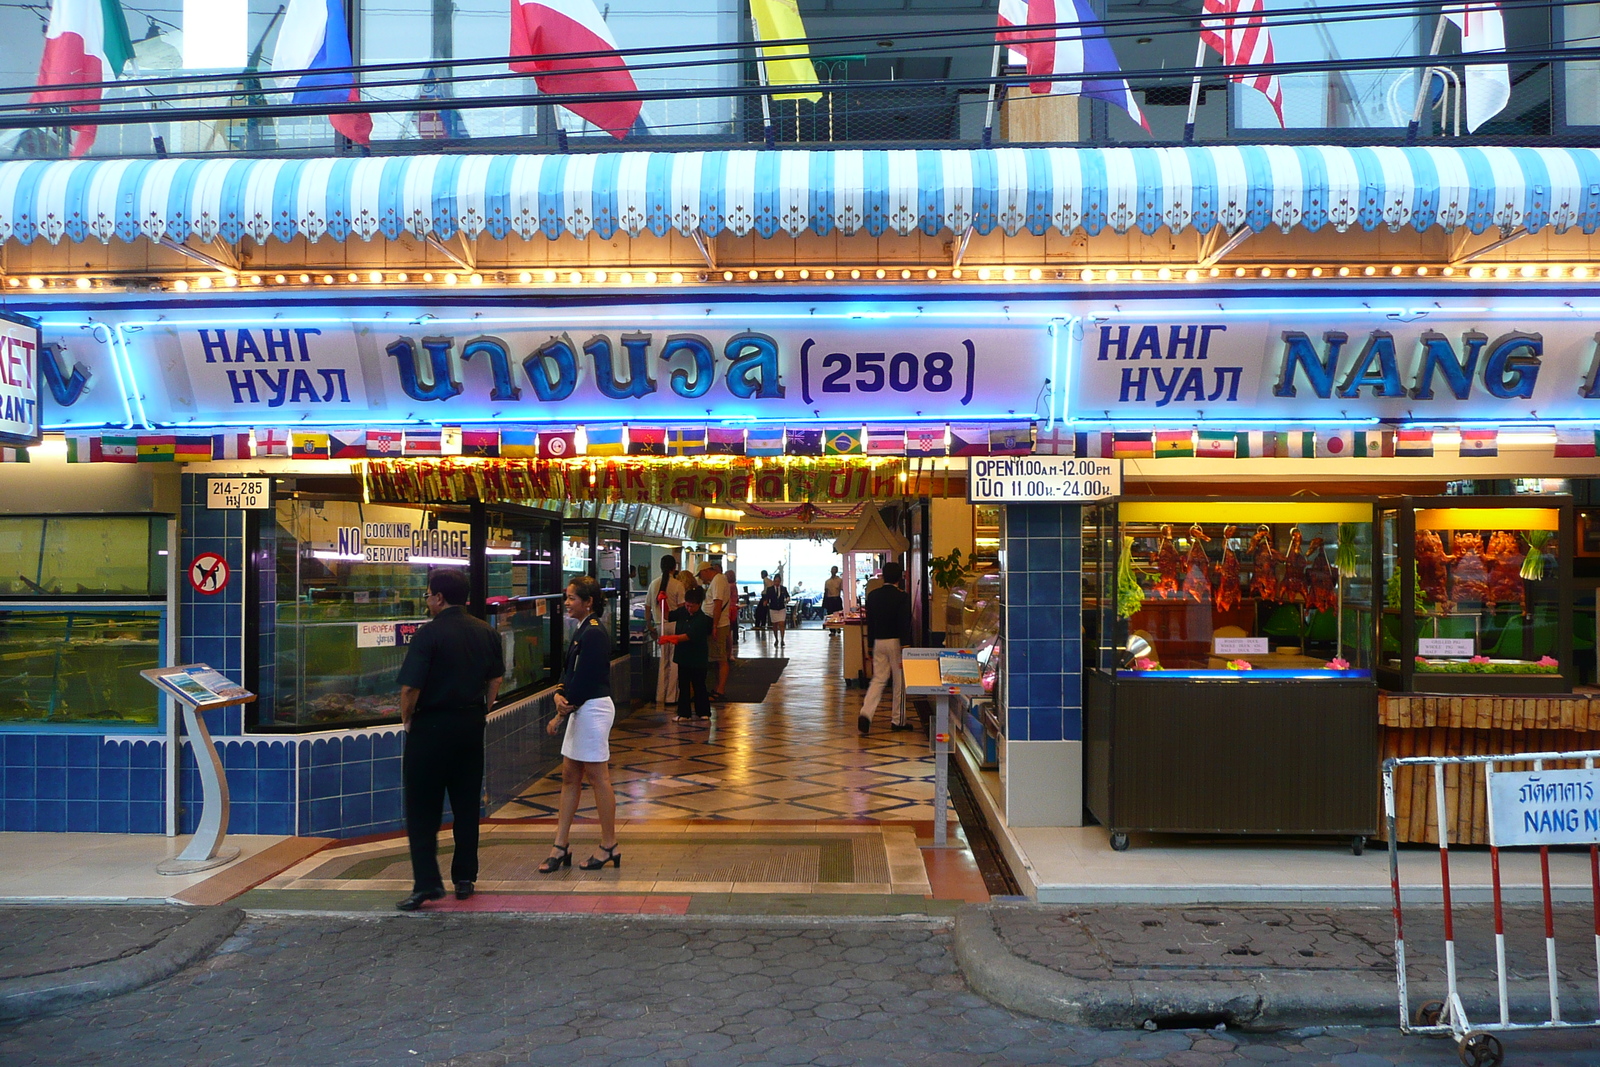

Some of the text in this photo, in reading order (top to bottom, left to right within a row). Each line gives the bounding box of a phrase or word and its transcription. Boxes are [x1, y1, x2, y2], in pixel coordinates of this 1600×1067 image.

[198, 328, 322, 363] НАНГ
[1097, 325, 1227, 361] НАНГ
[800, 338, 975, 405] (2508)
[1273, 329, 1544, 400] NANG
[226, 369, 351, 407] НУАЛ
[1119, 367, 1243, 407] НУАЛ
[976, 460, 1013, 477] OPEN
[213, 482, 262, 494] 214-285
[245, 496, 256, 506] 10
[976, 478, 1003, 497] เปิด
[338, 523, 410, 556] NO COOKING
[366, 530, 469, 561] SERVICE CHARGE
[1519, 775, 1594, 803] ภัตตาคาร
[1524, 808, 1579, 834] NANG
